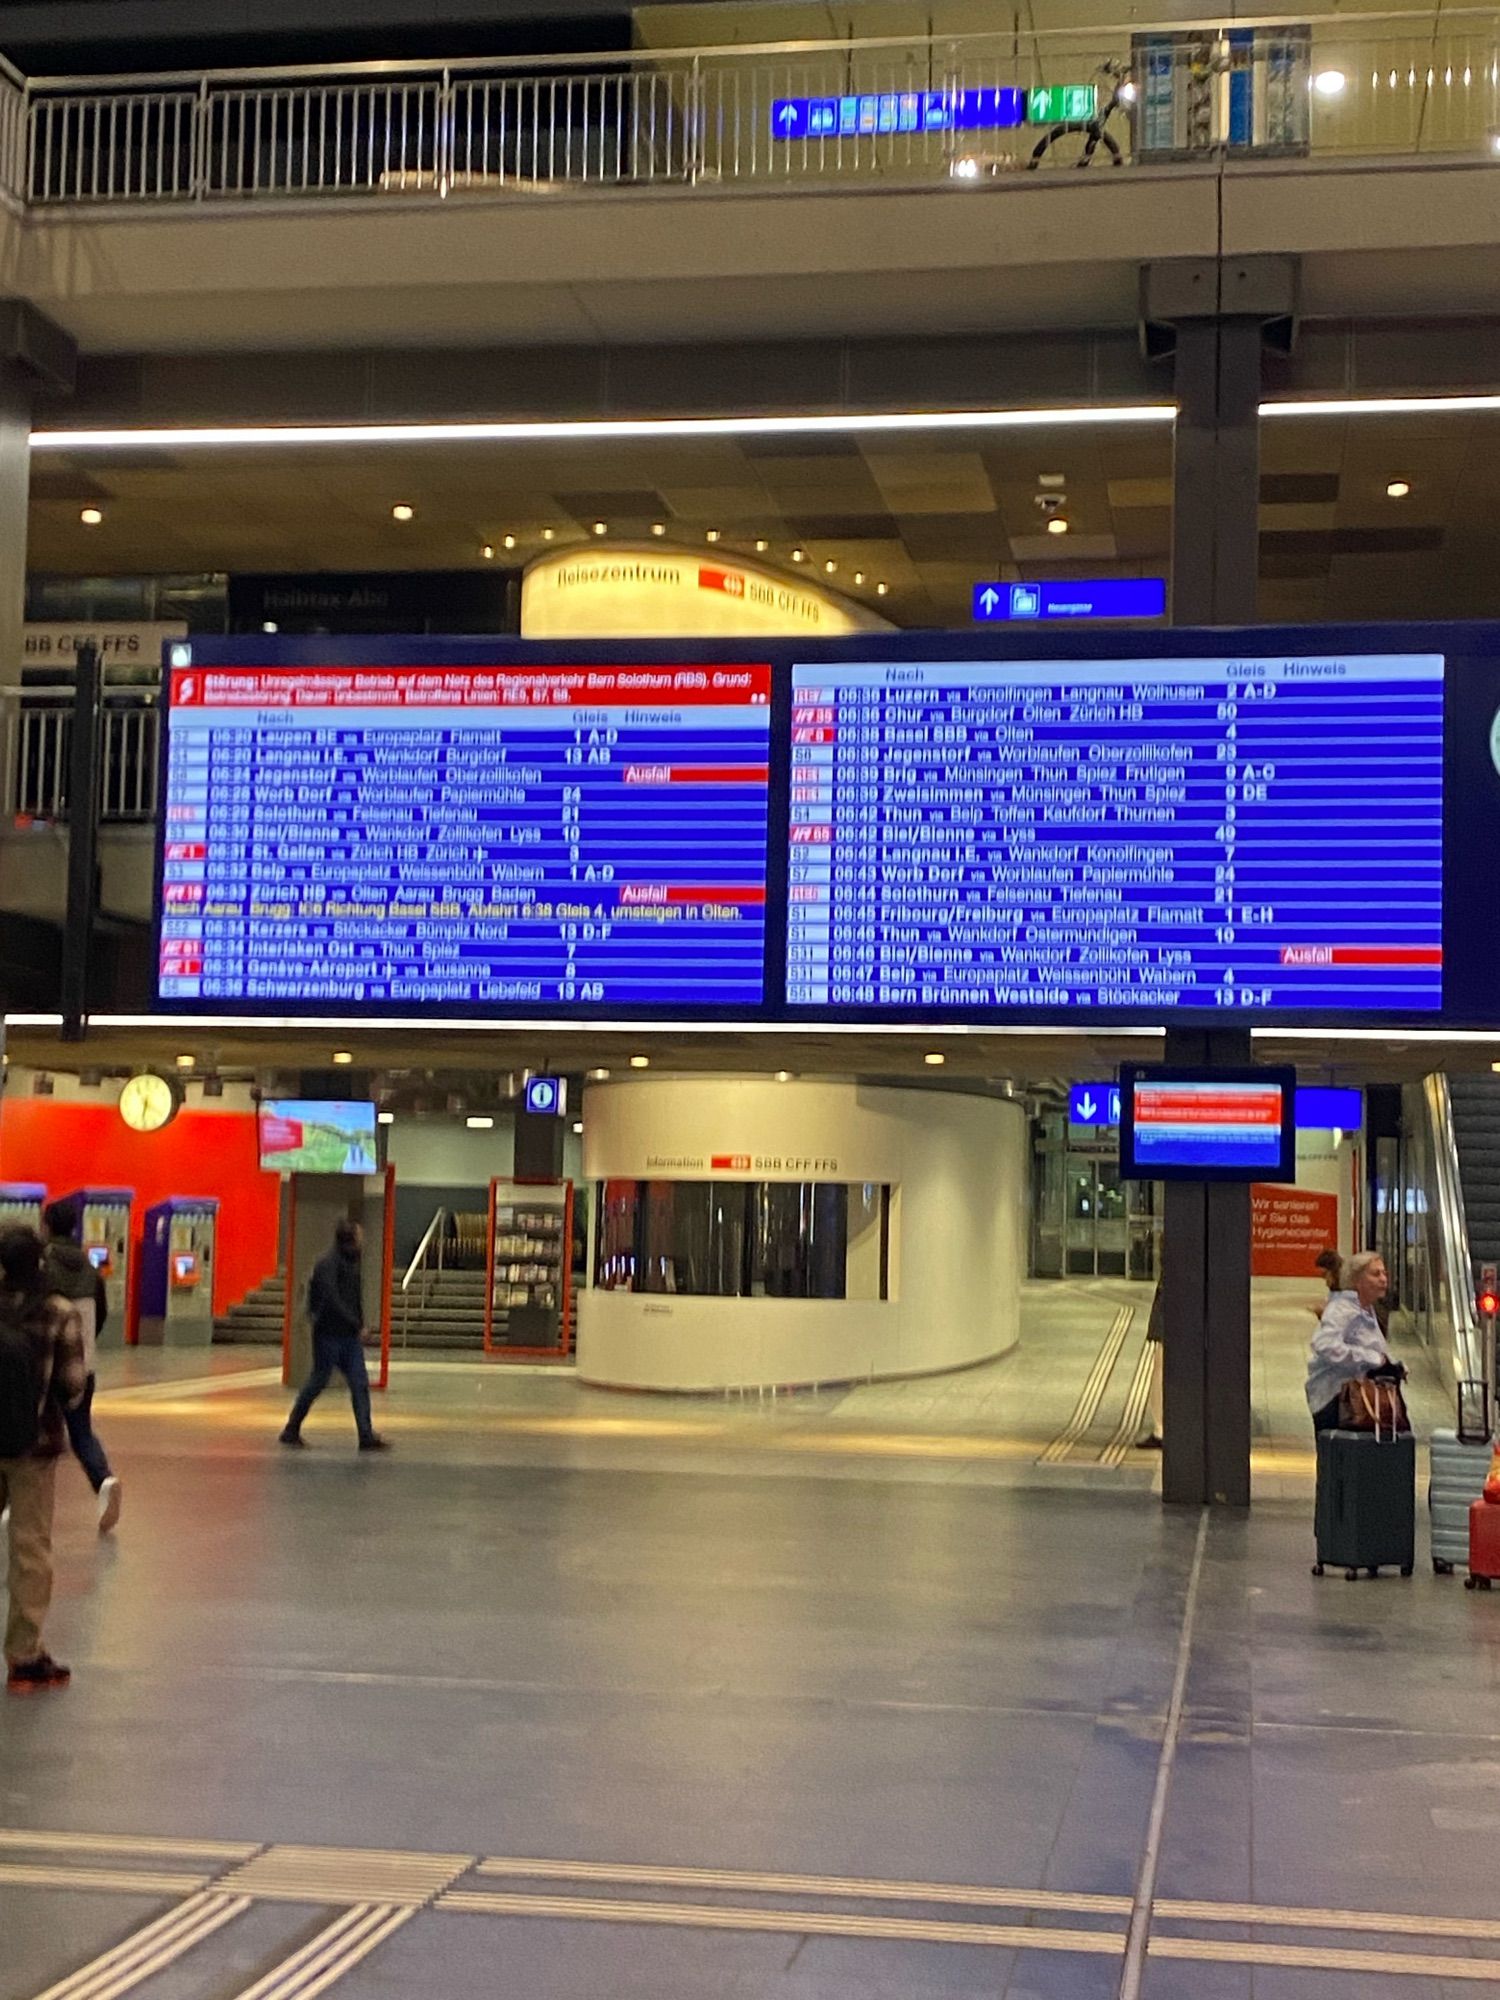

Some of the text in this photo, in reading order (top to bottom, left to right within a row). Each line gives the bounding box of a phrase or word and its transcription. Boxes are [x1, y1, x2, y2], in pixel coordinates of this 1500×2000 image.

[558, 562, 680, 588] Reisezentrum
[886, 662, 1346, 680] Nach Gleis Hinweis
[474, 674, 494, 687] des
[885, 683, 1276, 704] Luzern Konolfingen Langnau Wolhusen A-D
[258, 711, 682, 723] Nach Gleis Hinweis
[885, 705, 1143, 724] Chur Burgdorf Olten Zürich HB
[256, 729, 311, 747] Laupen
[363, 729, 443, 747] Europaplatz
[450, 729, 501, 744] Flamatt
[574, 729, 580, 744] 1
[884, 724, 1236, 741] Basel Olten 4
[256, 749, 610, 767] Langnau Wankdorf Burgdorf AB
[883, 745, 1193, 764] Jegenstorf Worblaufen Oberzollikofen
[255, 768, 670, 785] Jegenstorf Worblaufen Ausfall
[884, 765, 1184, 784] Brig Münsingen Thun Spiez Frutigen
[254, 787, 294, 801] Worb
[299, 787, 332, 801] Dorf
[358, 787, 433, 802] Worblaufen
[883, 786, 1267, 804] Zweisimmen Münsingen Thun Spiez DE
[254, 806, 327, 821] Solothurn
[883, 807, 1106, 824] Thun Belp Toffen Kaufdorf
[253, 825, 339, 840] Biel/Bienne
[366, 825, 430, 840] Wankdorf
[510, 826, 541, 844] Lyss
[883, 826, 1035, 844] Biel/Bienne Lyss
[278, 845, 325, 860] Gallen
[351, 845, 392, 860] Zürich
[882, 846, 1234, 865] Langnau Wankdorf Konolfingen 7
[252, 864, 285, 882] Belp
[312, 864, 390, 882] Europaplatz
[492, 865, 544, 880] Wabern
[570, 865, 577, 880] 1
[881, 867, 1174, 884] Worb Dorf Worblaufen Papiermühle
[251, 885, 299, 900] Zürich
[396, 886, 435, 901] Aarau
[492, 886, 535, 901] Baden
[623, 886, 667, 902] Ausfall
[881, 887, 1121, 902] Solothurn Felsenau Tiefenau
[326, 903, 385, 920] Richtung
[611, 904, 681, 921] umsteigen
[881, 907, 1232, 925] Fribourg/Freiburg Europaplatz Flamatt 1
[475, 923, 507, 938] Nord
[881, 927, 1234, 945] Thun Wankdorf Ostermundigen 10
[248, 941, 414, 957] Interlaken Ost Thun
[880, 947, 1332, 966] Biel/Bienne Wankdorf Zollikofen Lyss Ausfall
[880, 967, 1234, 985] Belp Europaplatz Weissenbühl Wabern 4
[247, 980, 603, 1000] Schwarzenburg Europaplatz Liebefeld AB
[879, 987, 1272, 1005] Bern Brünnen Westside Stöckacker D-F
[755, 1158, 781, 1170] SBB
[1252, 1198, 1270, 1210] Wir
